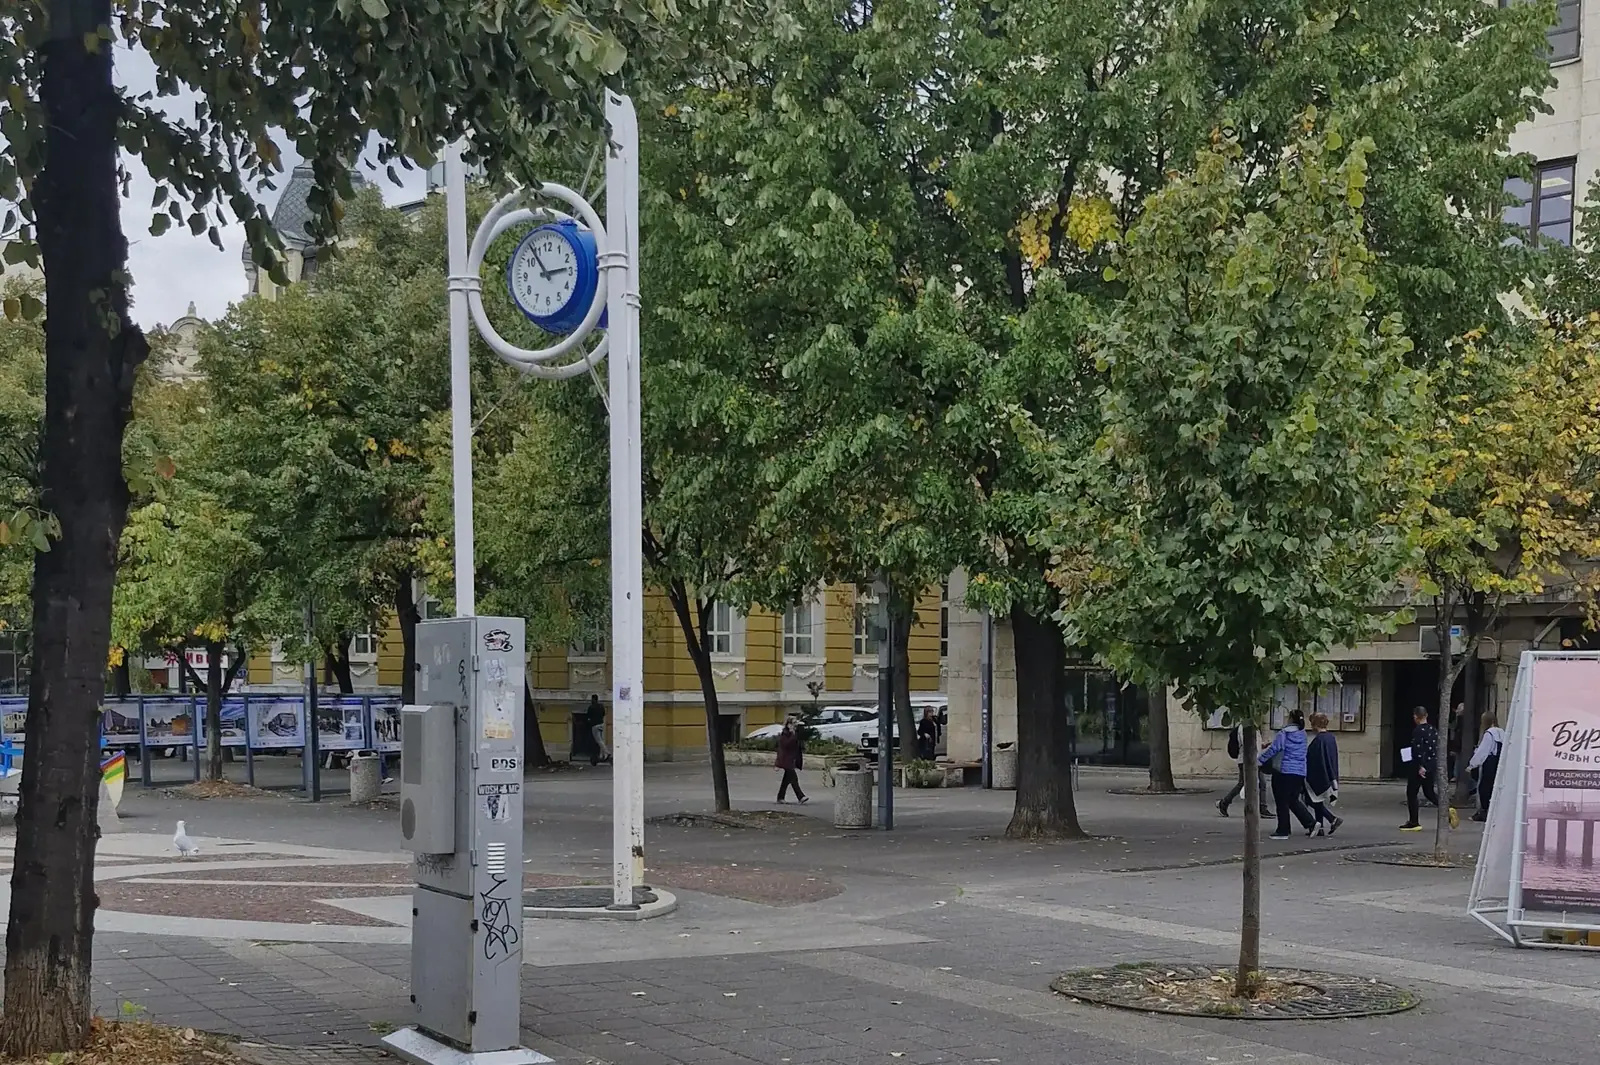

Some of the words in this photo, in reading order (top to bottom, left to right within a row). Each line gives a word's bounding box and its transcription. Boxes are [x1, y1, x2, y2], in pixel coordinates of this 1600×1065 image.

[543, 242, 553, 252] 12
[557, 245, 561, 254] 1
[526, 258, 536, 268] 10
[564, 254, 570, 264] 2
[568, 266, 574, 276] 3
[523, 272, 528, 282] 9
[526, 285, 532, 295] 8
[564, 281, 570, 290] 4
[534, 293, 540, 303] 7
[546, 296, 551, 306] 6
[556, 292, 562, 302] 5
[1554, 750, 1590, 763] ИЗВЪН
